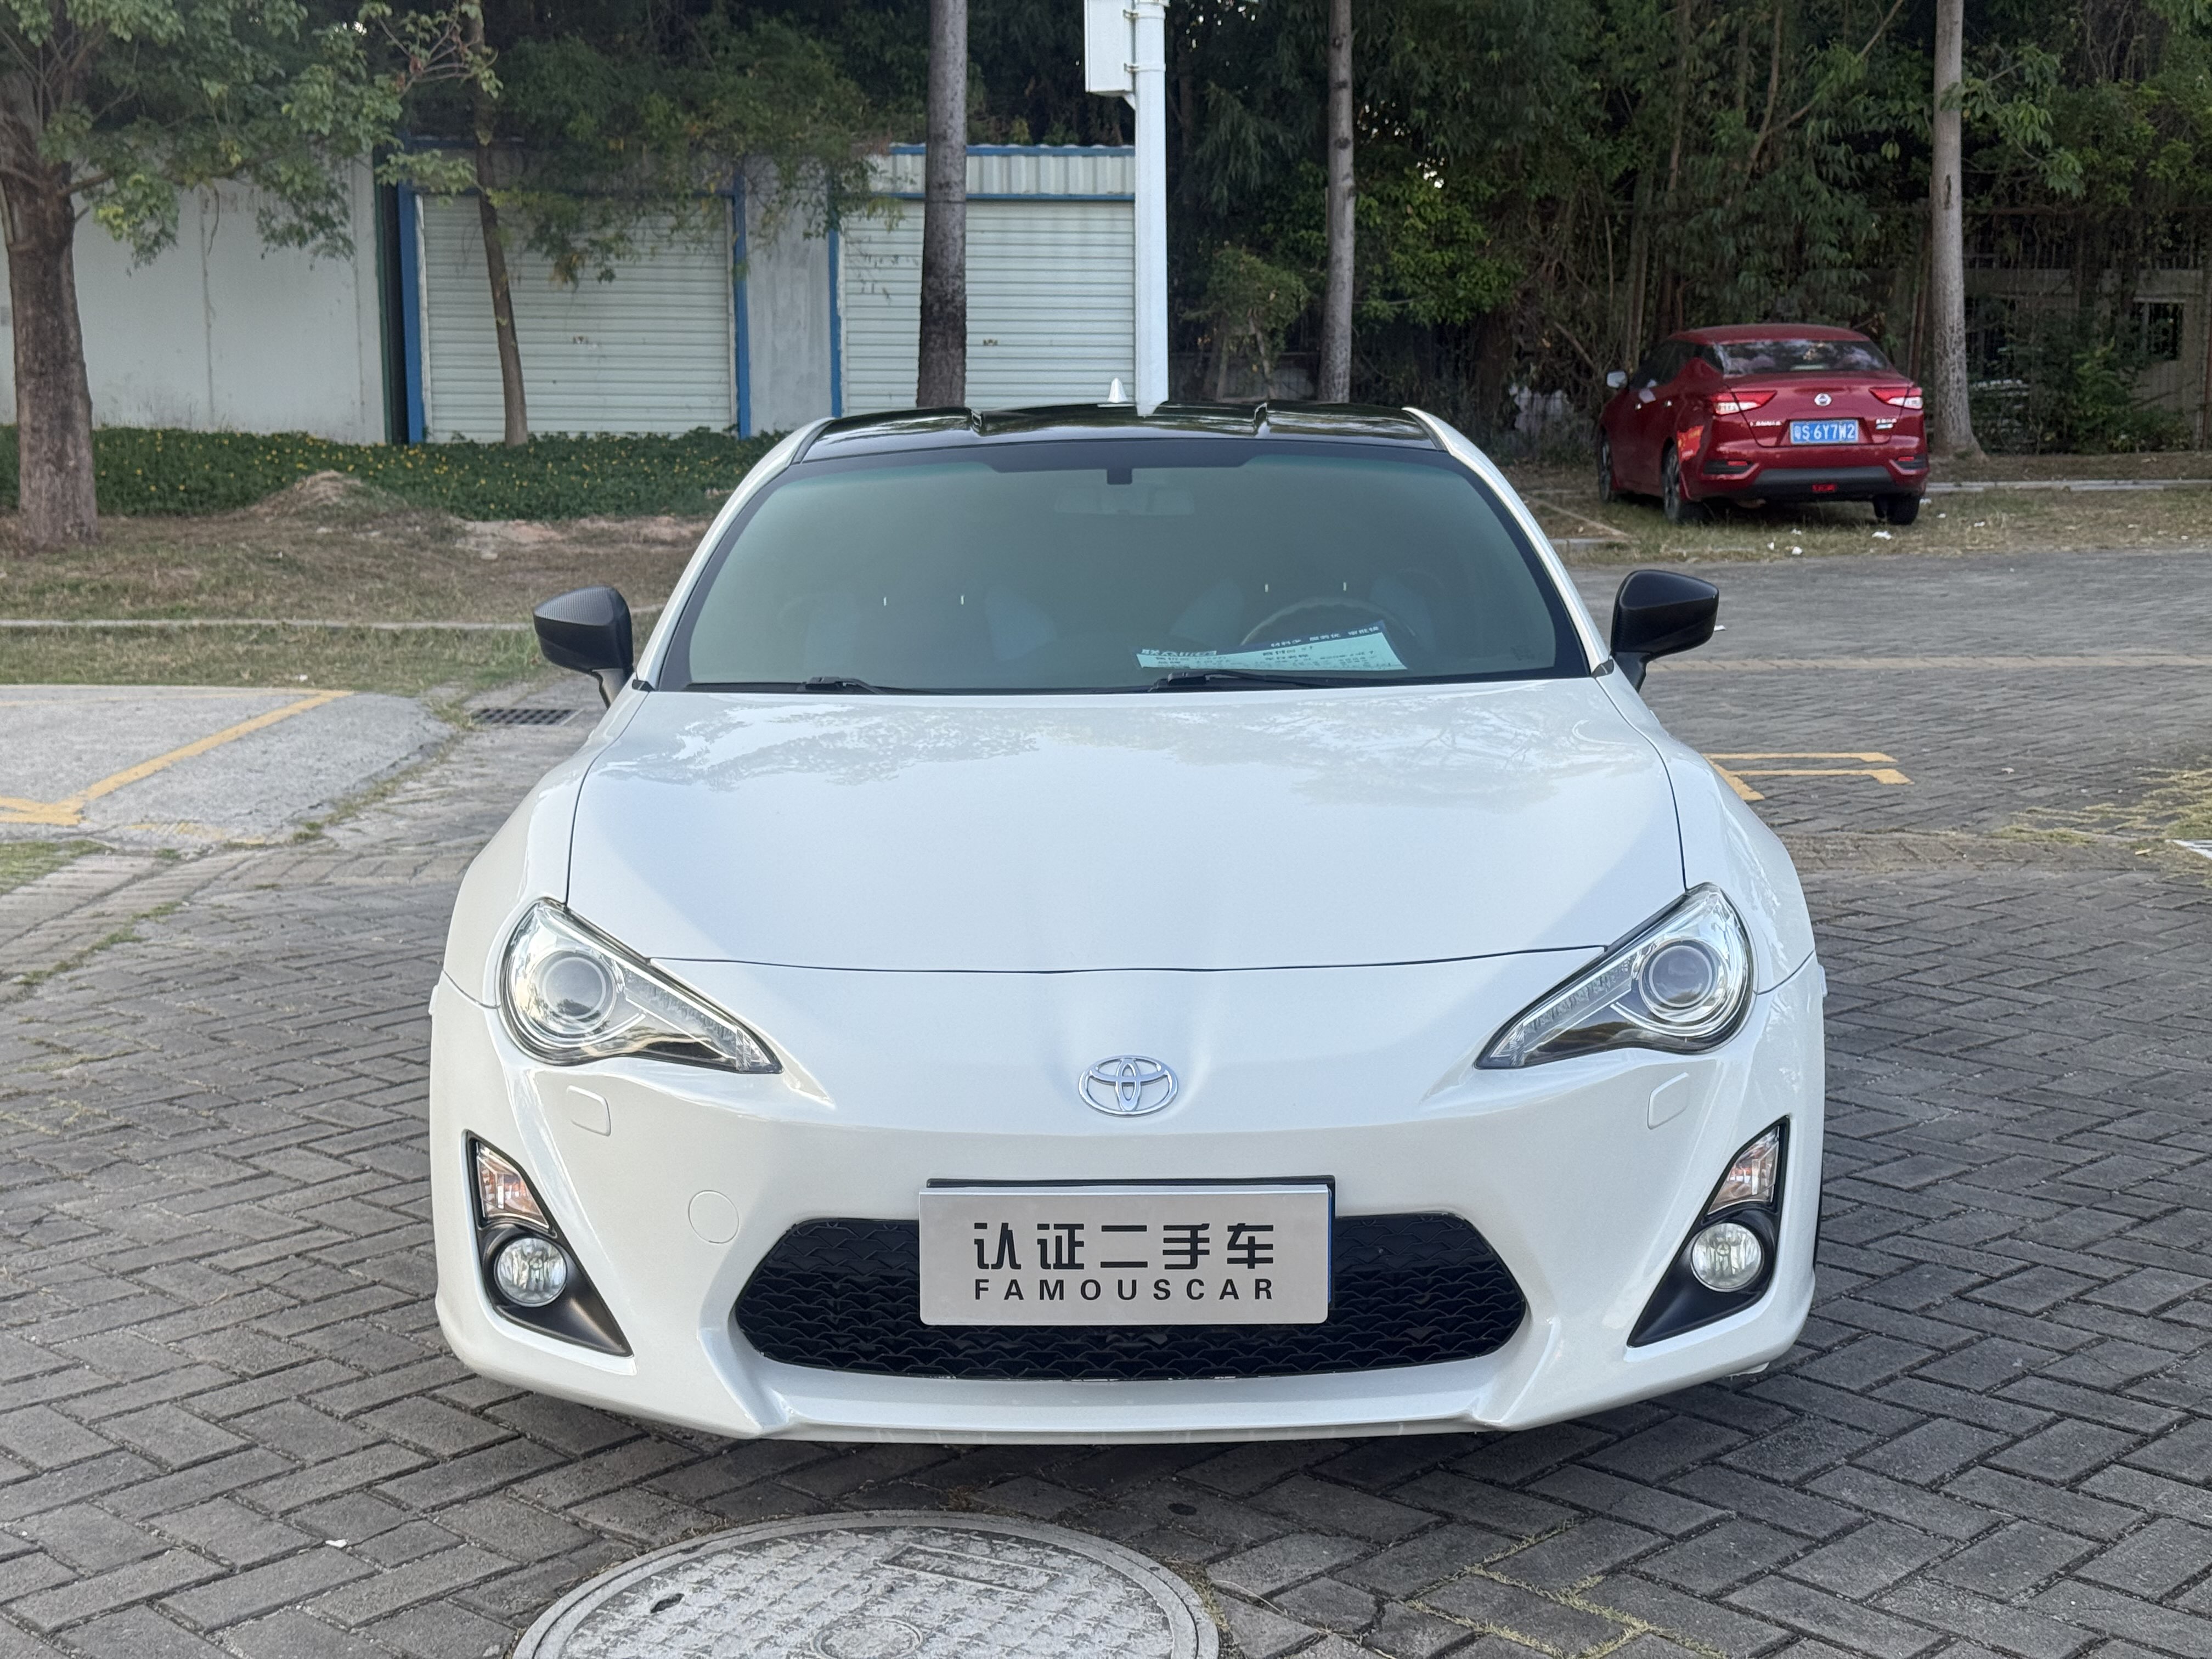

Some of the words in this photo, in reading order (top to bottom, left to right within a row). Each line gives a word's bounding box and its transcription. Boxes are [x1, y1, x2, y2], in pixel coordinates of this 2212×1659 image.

[974, 1223, 1273, 1269] 认证二手车
[975, 1278, 1272, 1300] FAMOUSCAR
